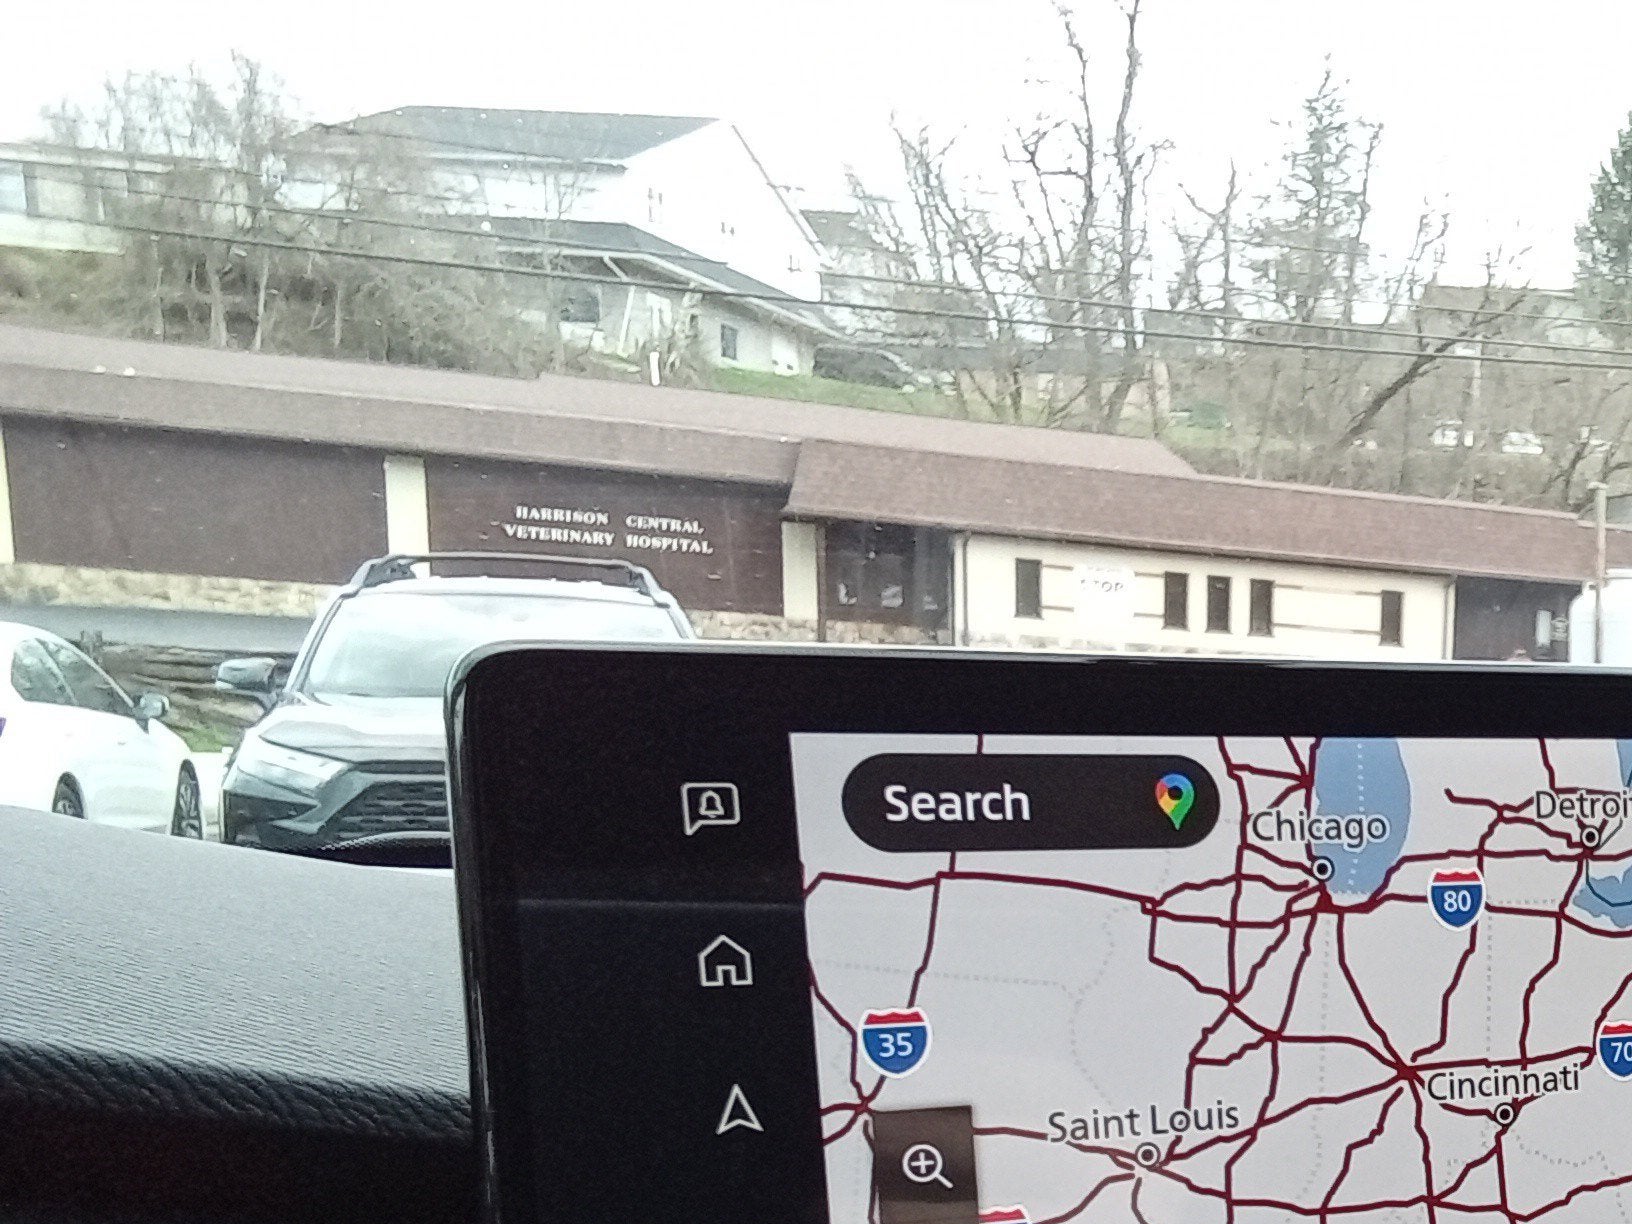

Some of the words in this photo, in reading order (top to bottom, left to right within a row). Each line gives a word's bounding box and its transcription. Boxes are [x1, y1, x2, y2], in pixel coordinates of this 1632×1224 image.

[515, 505, 609, 526] HARRISON
[625, 515, 704, 534] CENTRAL
[504, 523, 615, 546] VETERINARY
[626, 534, 713, 554] HOSPITAL
[884, 784, 1031, 822] Search
[1252, 812, 1387, 848] Chicago
[1443, 892, 1471, 912] 80
[878, 1034, 913, 1058] 35
[1427, 1063, 1580, 1101] Cincinnati
[1048, 1109, 1141, 1142] Saint
[1150, 1100, 1240, 1134] Louis
